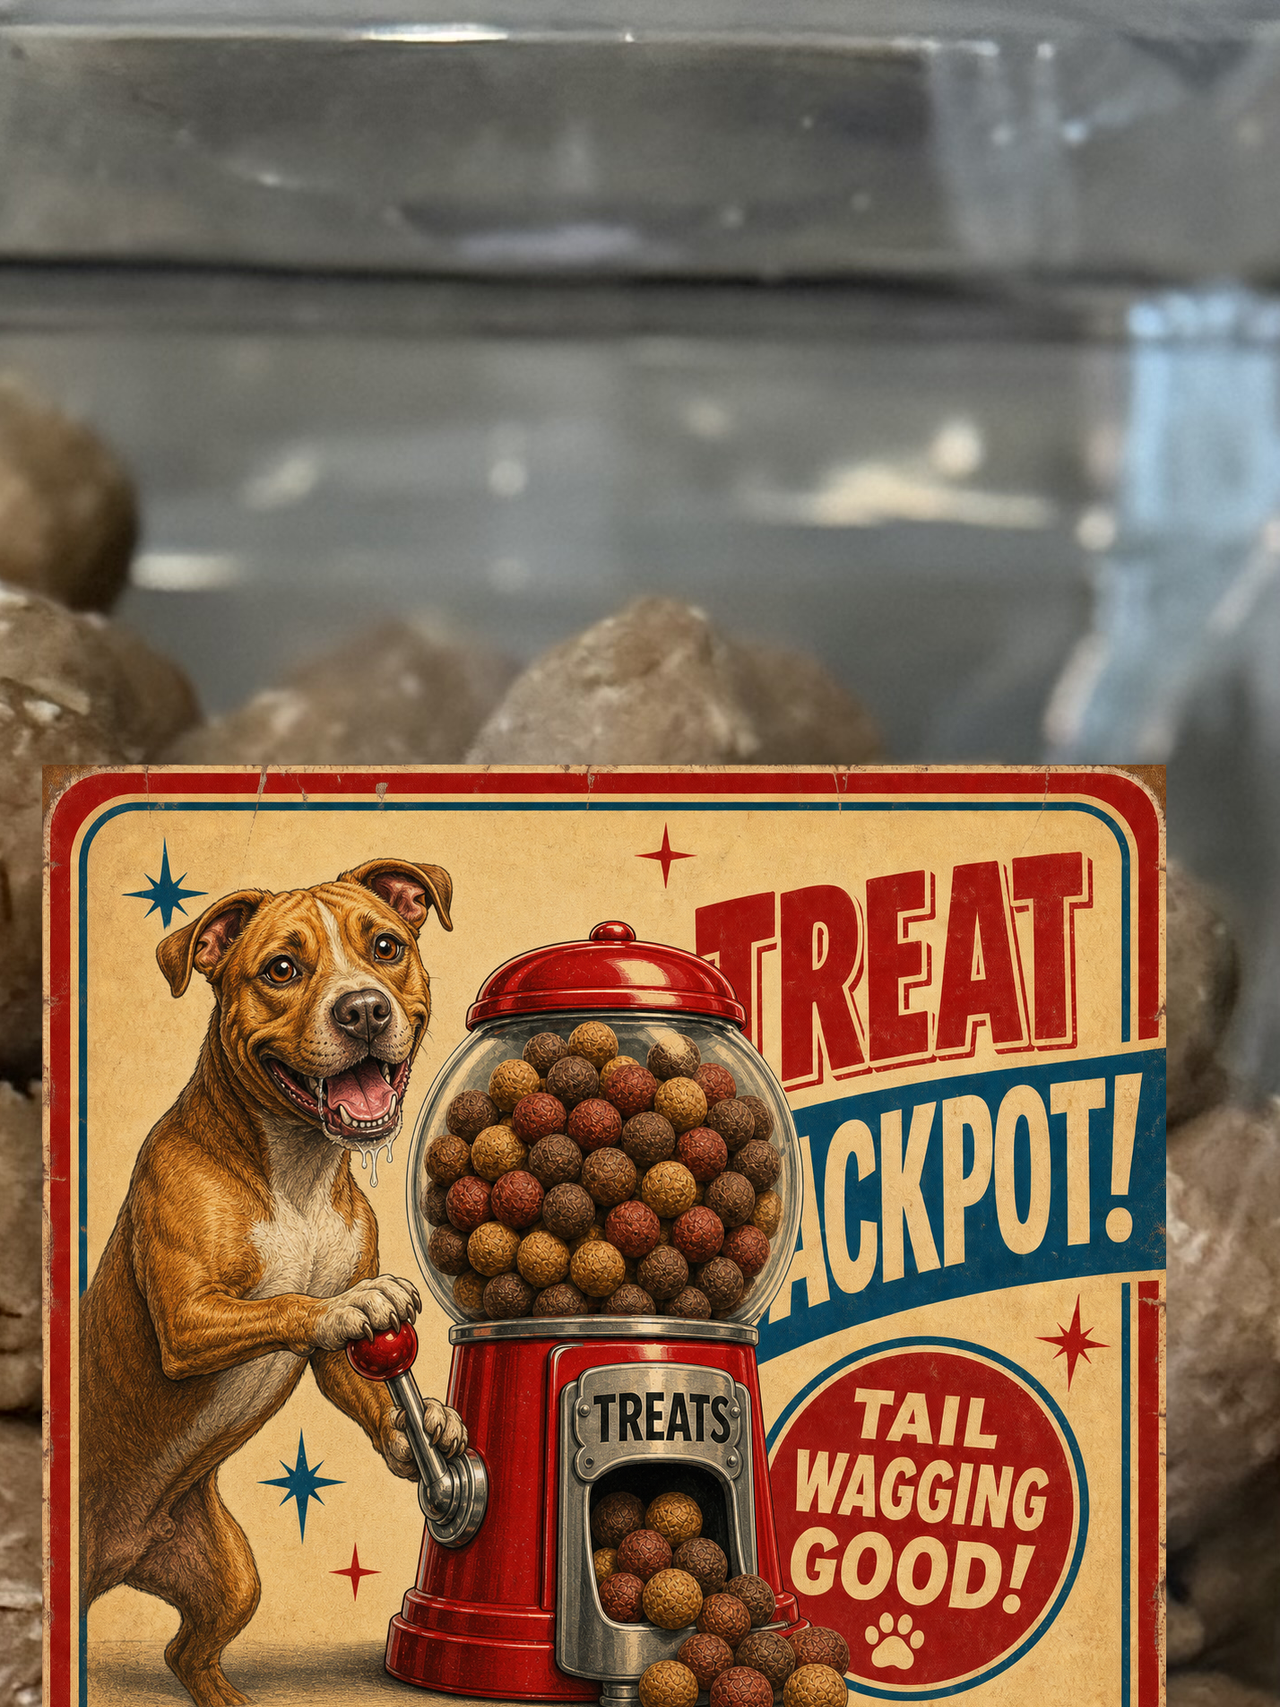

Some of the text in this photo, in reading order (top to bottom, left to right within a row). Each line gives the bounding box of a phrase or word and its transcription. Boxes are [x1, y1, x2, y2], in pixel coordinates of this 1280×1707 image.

[695, 851, 1093, 1092] TREAT
[768, 1072, 1143, 1324] ACKPOT!
[593, 1391, 731, 1444] TREATS
[854, 1388, 997, 1449] TAIL
[796, 1449, 1049, 1531] WAGGING
[790, 1527, 1036, 1614] GOOD!
